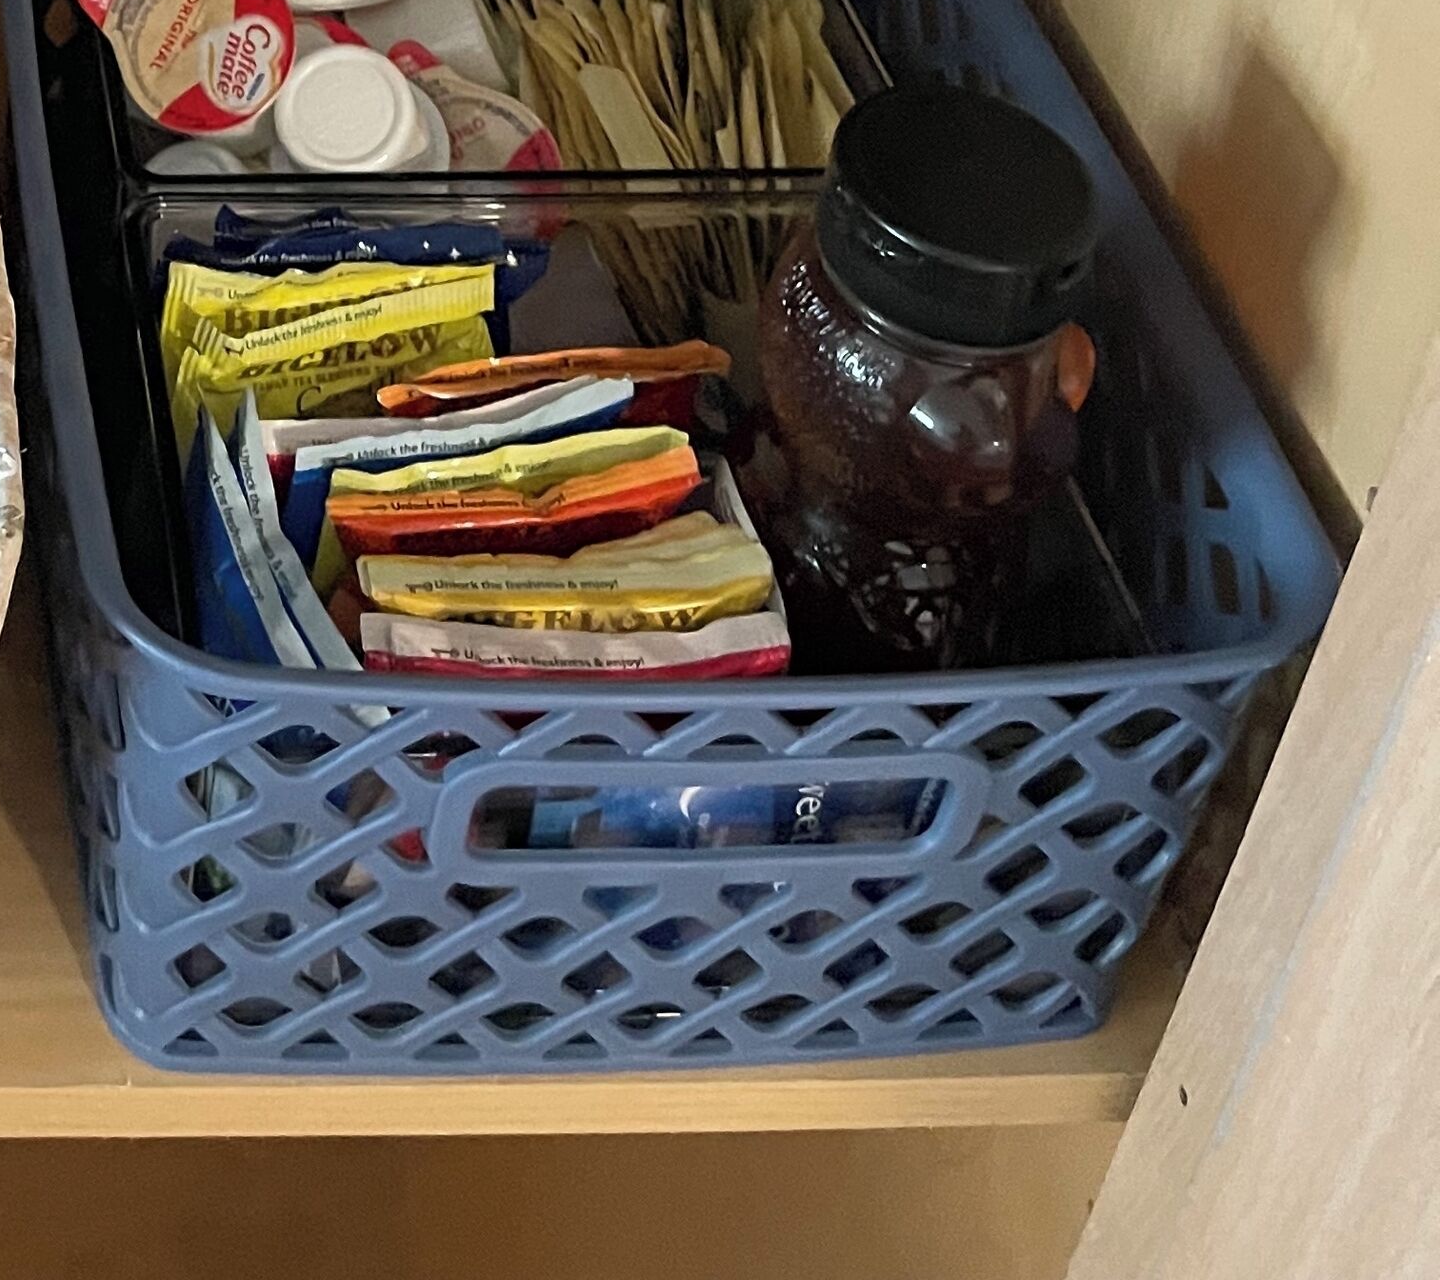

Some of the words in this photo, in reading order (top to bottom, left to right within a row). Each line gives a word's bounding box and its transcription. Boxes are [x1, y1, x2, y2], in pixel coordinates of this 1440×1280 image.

[216, 31, 242, 96] mate
[231, 23, 271, 100] Coffee
[245, 331, 281, 351] Unlock
[357, 445, 397, 460] Unlock
[399, 442, 419, 455] the
[391, 499, 434, 512] Unlock
[434, 578, 477, 590] Unlock
[480, 578, 502, 589] the
[508, 655, 530, 666] the
